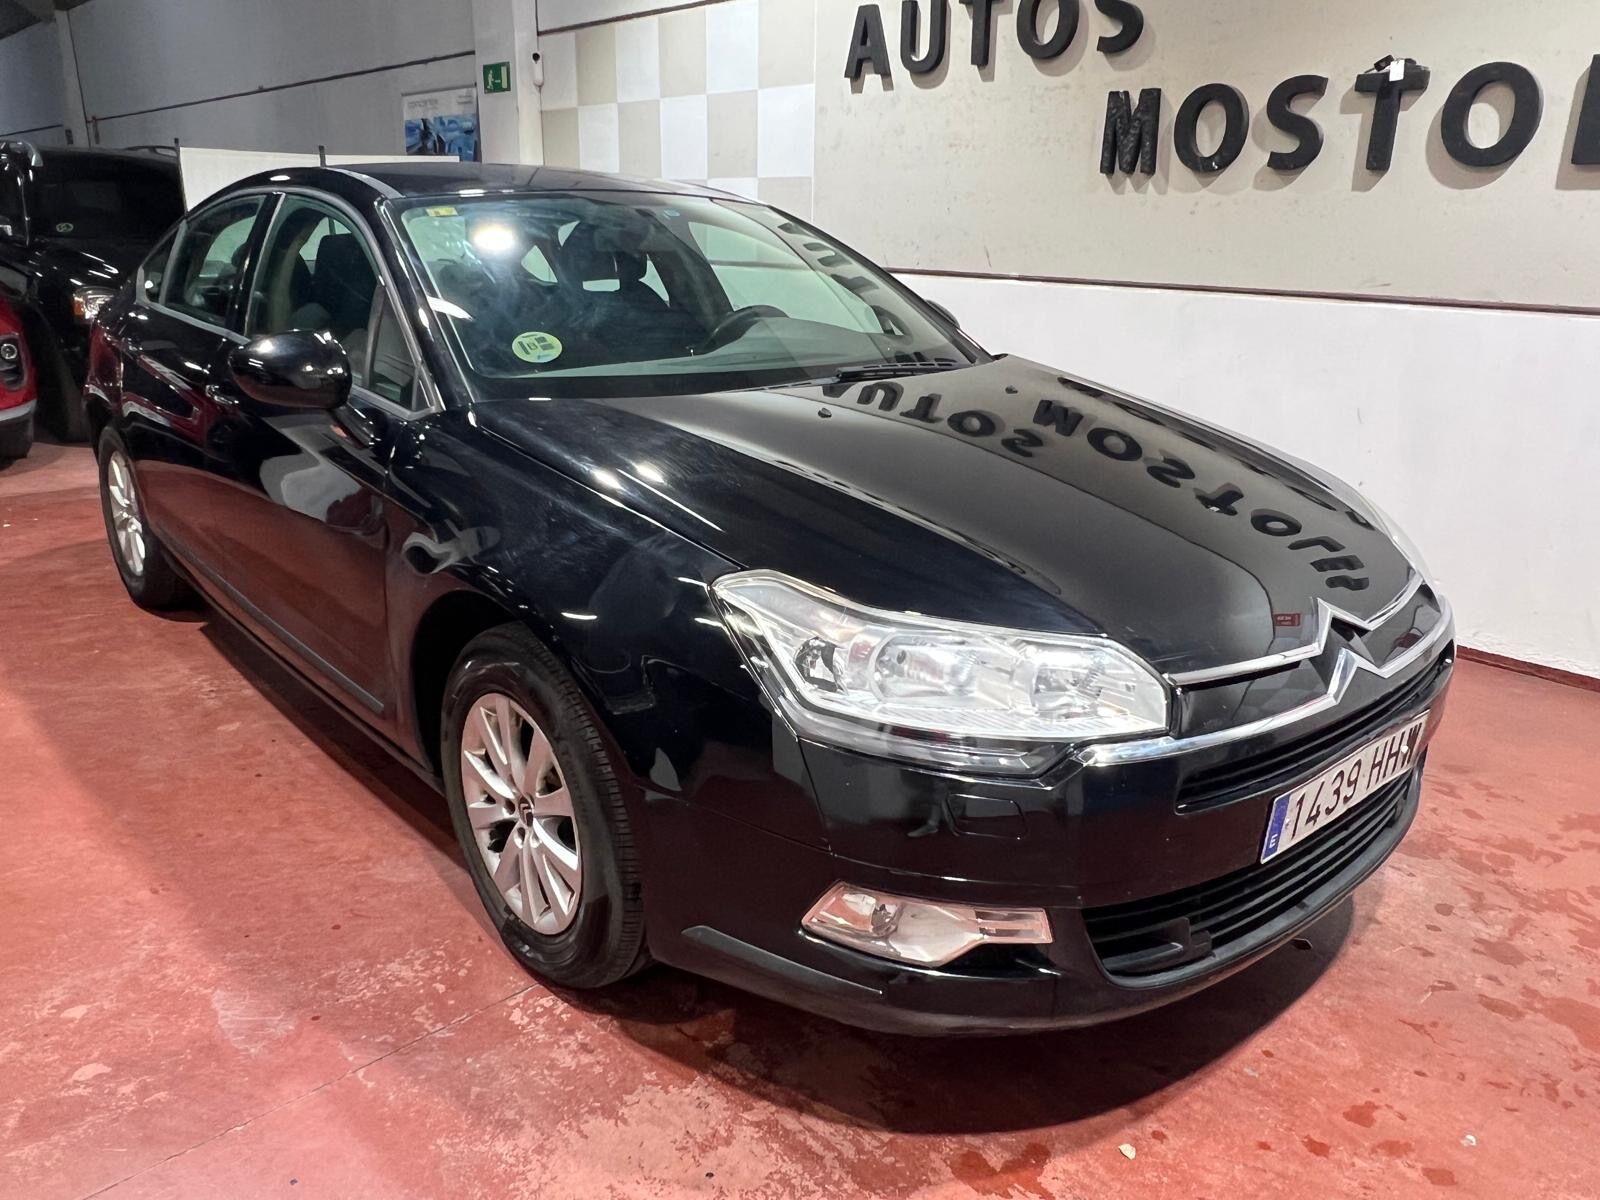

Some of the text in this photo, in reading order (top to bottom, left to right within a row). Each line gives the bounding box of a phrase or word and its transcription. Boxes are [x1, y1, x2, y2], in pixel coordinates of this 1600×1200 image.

[844, 0, 1144, 79] AUTOS
[1291, 758, 1362, 840] 1439
[1269, 833, 1279, 848] E
